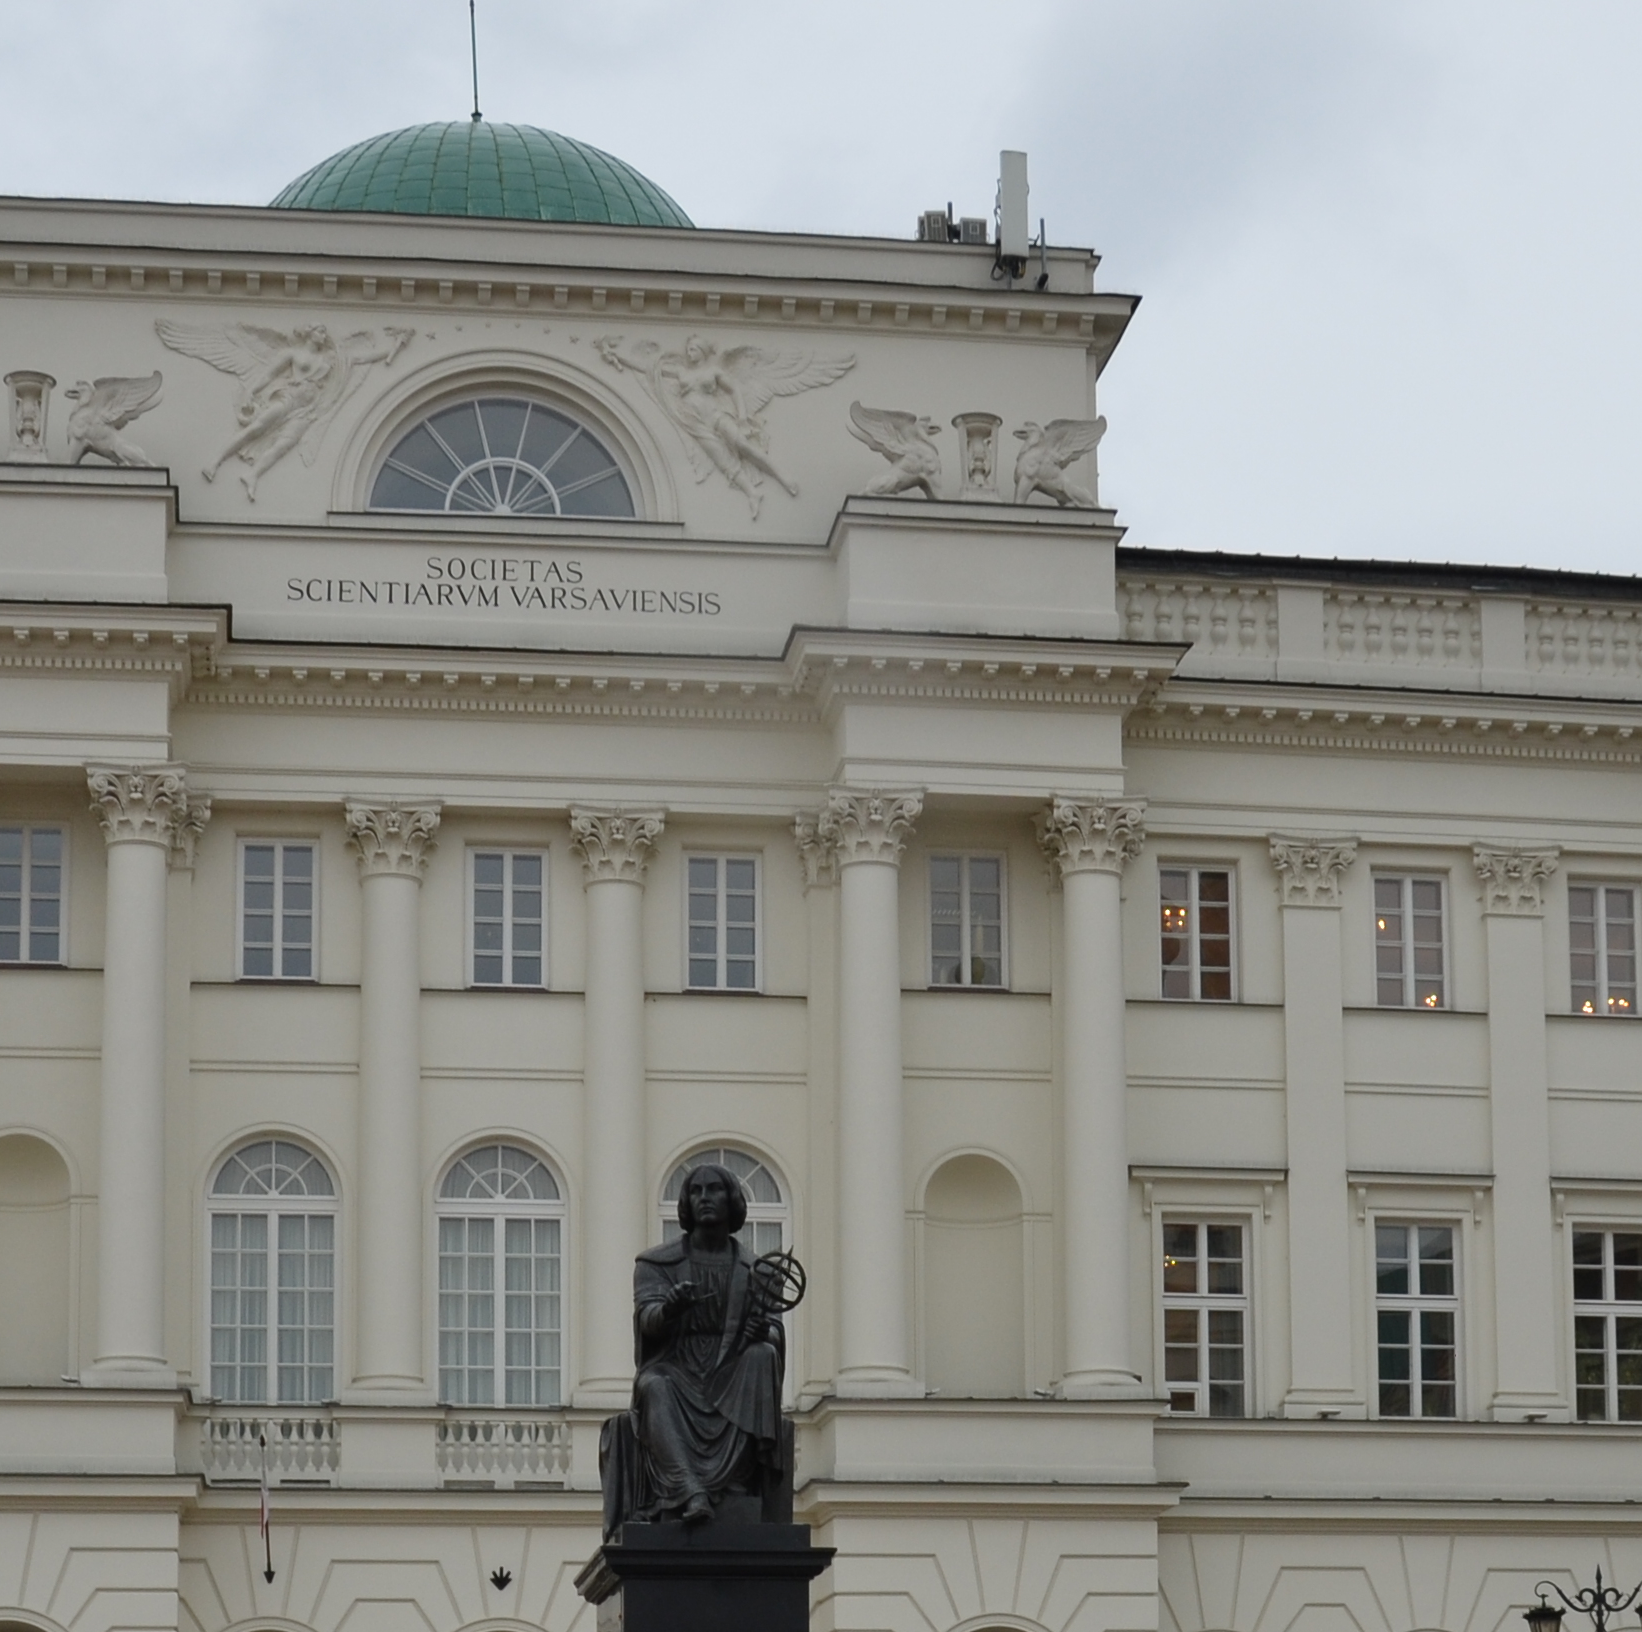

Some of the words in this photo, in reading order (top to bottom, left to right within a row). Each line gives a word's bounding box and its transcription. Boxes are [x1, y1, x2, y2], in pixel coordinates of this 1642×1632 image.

[426, 556, 583, 584] SOCIETAS
[286, 577, 500, 608] SCIENTIARVM
[509, 585, 721, 616] VARSAVIENSIS
